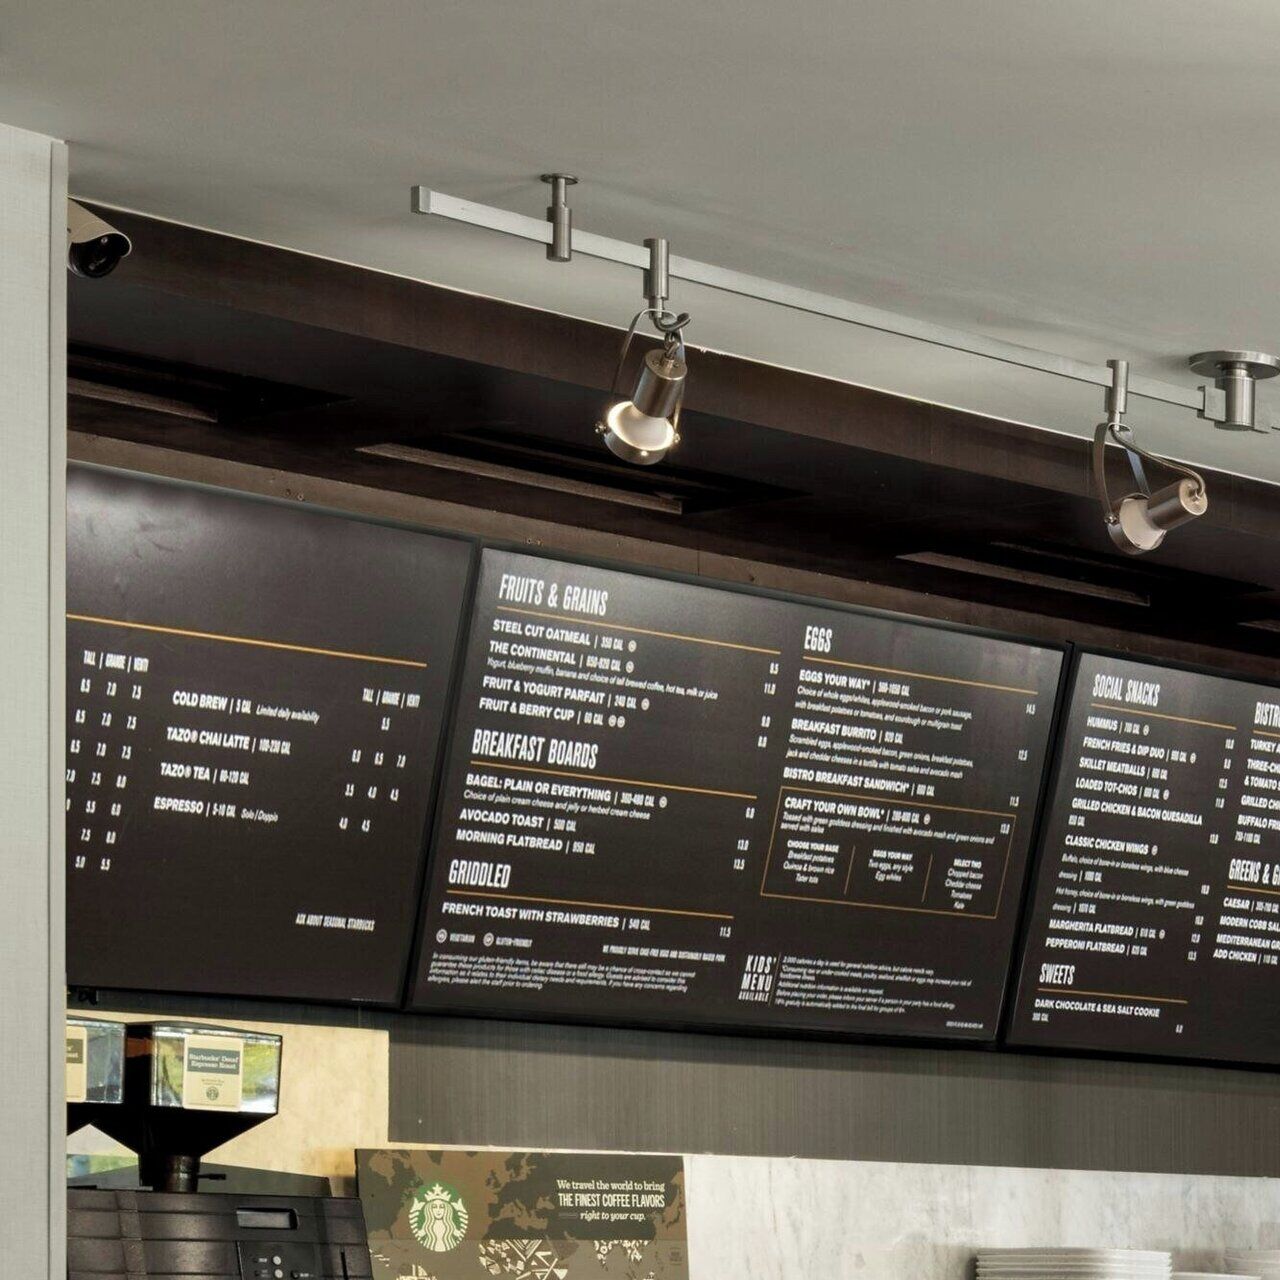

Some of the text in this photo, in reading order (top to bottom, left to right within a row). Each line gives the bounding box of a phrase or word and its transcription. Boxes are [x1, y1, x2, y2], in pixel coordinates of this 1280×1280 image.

[499, 574, 608, 616] FRUITS & GRAINS
[493, 619, 590, 645] STEEL CUT OATMEAL
[804, 626, 832, 653] EGGS
[490, 640, 576, 665] THE CONTINENTAL
[799, 669, 823, 683] EGGS
[825, 673, 847, 687] YOUR
[483, 676, 605, 704] FRUIT & YOGURT PARFAIT
[1093, 674, 1160, 706] SOCIAL SNACKS
[173, 691, 319, 724] COLD BREW Limited daily availability
[479, 697, 574, 720] FRUIT & BERRY CUP
[791, 718, 877, 740] BREAKFAST BURRITO
[1087, 716, 1118, 731] HUMMUS
[167, 727, 250, 749] TAZO® CHAI LATTE
[1083, 736, 1165, 759] FRENCH FRIES & DIP DUO
[1251, 739, 1276, 752] TURKEY
[472, 729, 598, 769] BREAKFAST BOARDS
[161, 762, 210, 780] TAZO® TEA
[1079, 757, 1145, 776] SKILLET MEATBALLS
[466, 773, 611, 801] BAGEL: PLAIN OR EVERYTHING
[783, 767, 814, 781] BISTRO
[815, 771, 863, 787] BREAKFAST
[1076, 777, 1138, 796] LOADED TOT-CHOS
[1244, 776, 1249, 785] &
[1251, 776, 1277, 790] TOMATO
[154, 796, 204, 814] ESPRESSO
[464, 789, 487, 801] Choice
[487, 793, 496, 803] of
[494, 794, 511, 803] plain
[511, 797, 531, 805] cream
[532, 798, 554, 808] cheese
[555, 802, 568, 810] and
[566, 802, 580, 813] jelly
[588, 805, 610, 815] herbed
[610, 809, 628, 817] cream
[629, 810, 650, 820] cheese
[785, 797, 812, 810] CRAFT
[814, 801, 836, 813] YOUR
[837, 803, 857, 816] OWN
[1072, 798, 1202, 825] GRILLED CHICKEN & BACON QUESADILLA
[1241, 795, 1268, 808] GRILLED
[460, 808, 544, 828] AVOCADO TOAST
[1238, 814, 1267, 828] BUFFALO
[456, 829, 563, 850] MORNING FLATBREAD
[1065, 835, 1149, 855] CLASSIC CHICKEN WINGS
[449, 859, 511, 888] GRIDDLED
[1229, 859, 1261, 883] GREENS
[1262, 864, 1270, 884] &
[1223, 897, 1250, 909] CAESAR
[442, 902, 619, 928] FRENCH TOAST WITH STRAWBERRIES
[1220, 916, 1248, 927] MODERN
[1249, 919, 1267, 930] COBB
[1049, 919, 1133, 936] MARGHERITA FLATBREAD
[1045, 937, 1125, 953] PEPPERONI FLATBREAD
[1216, 934, 1271, 948] MEDITERRANEAN
[1213, 949, 1257, 962] ADD CHICKEN
[741, 973, 772, 991] MENU
[1039, 963, 1075, 985] SWEETS
[1035, 999, 1160, 1017] DARK CHOCOLATE & SEA SALT COOKIE
[557, 1180, 665, 1192] We travel the world to bring
[558, 1193, 666, 1207] THE FINEST COFFEE FLAVORS
[580, 1210, 646, 1222] right to your cup.
